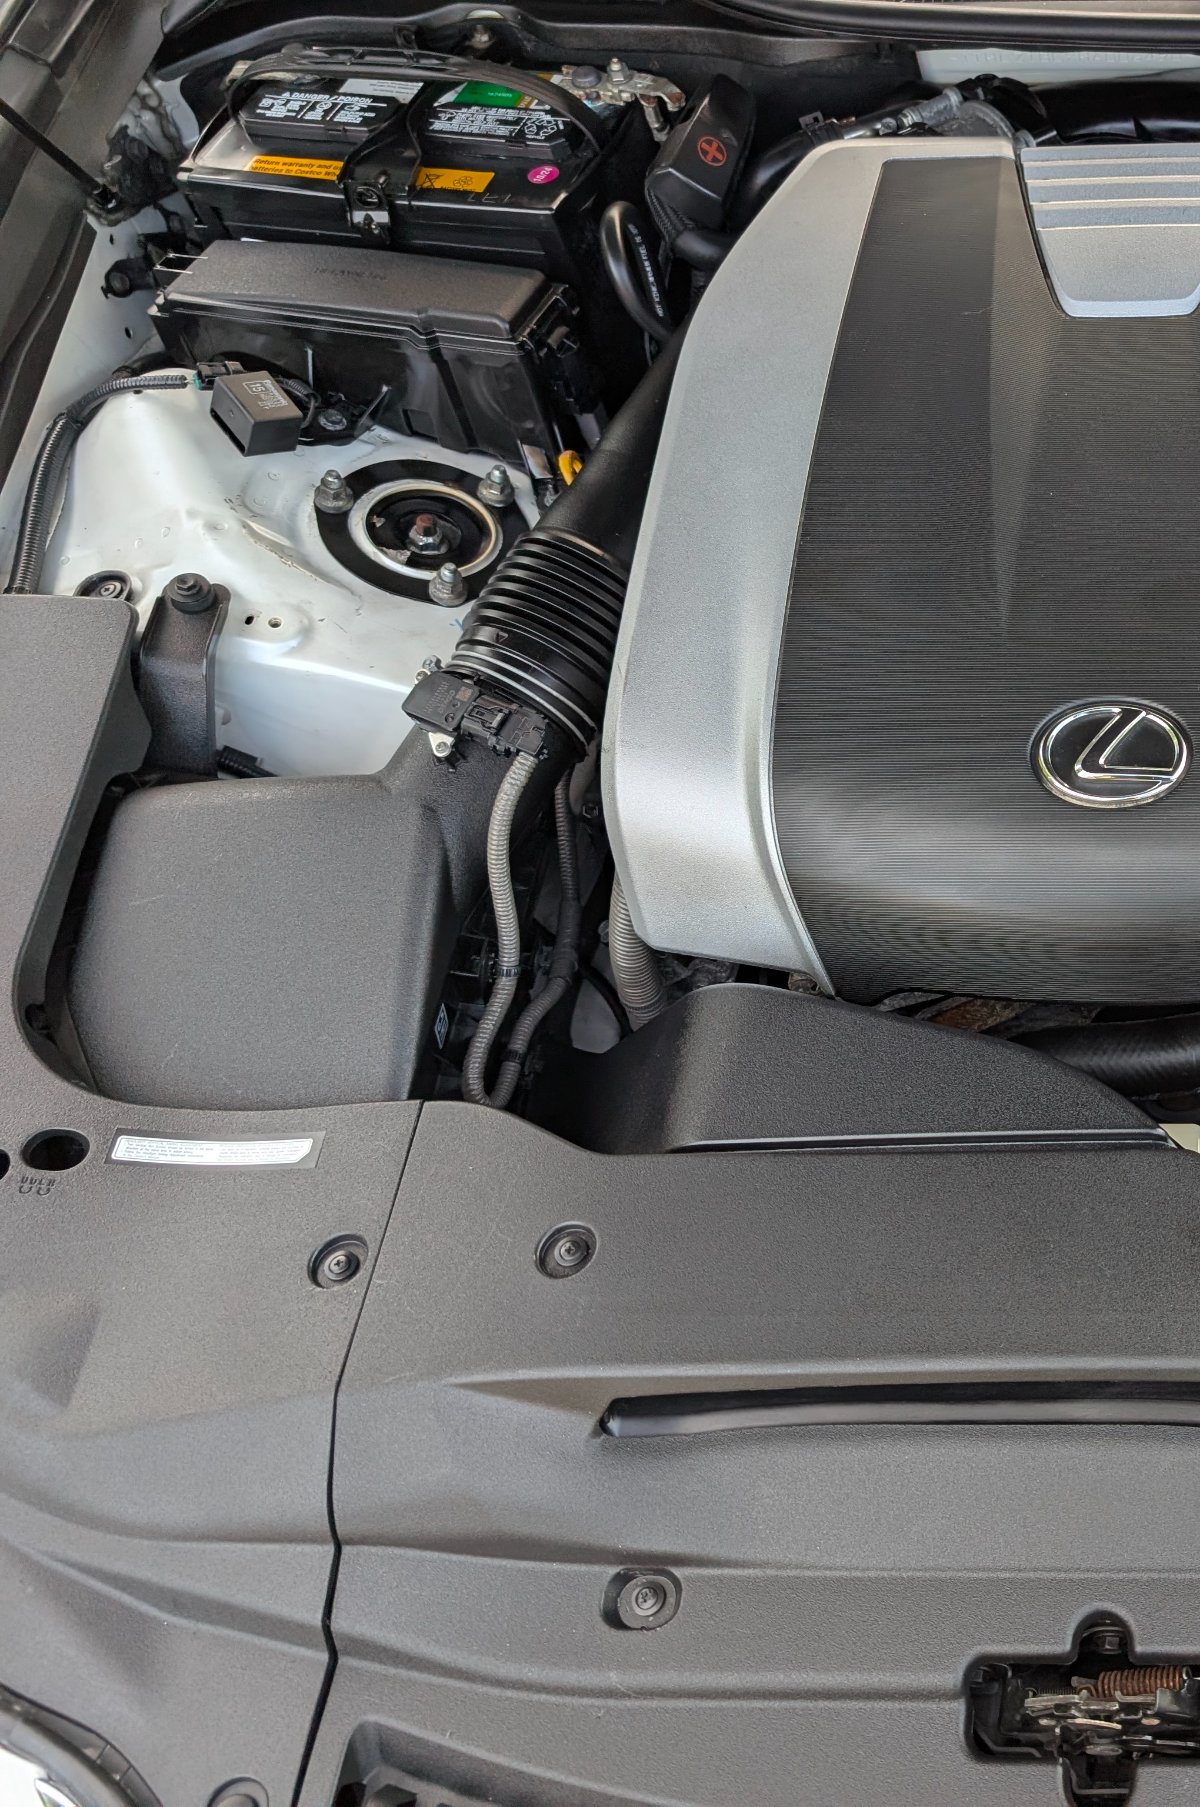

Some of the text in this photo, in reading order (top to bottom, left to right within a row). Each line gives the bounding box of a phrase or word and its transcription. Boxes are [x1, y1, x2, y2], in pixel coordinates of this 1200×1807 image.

[292, 91, 331, 101] DANGER
[338, 95, 373, 104] POISON
[253, 158, 281, 167] Return
[281, 161, 315, 170] warranty
[293, 168, 323, 177] Costco
